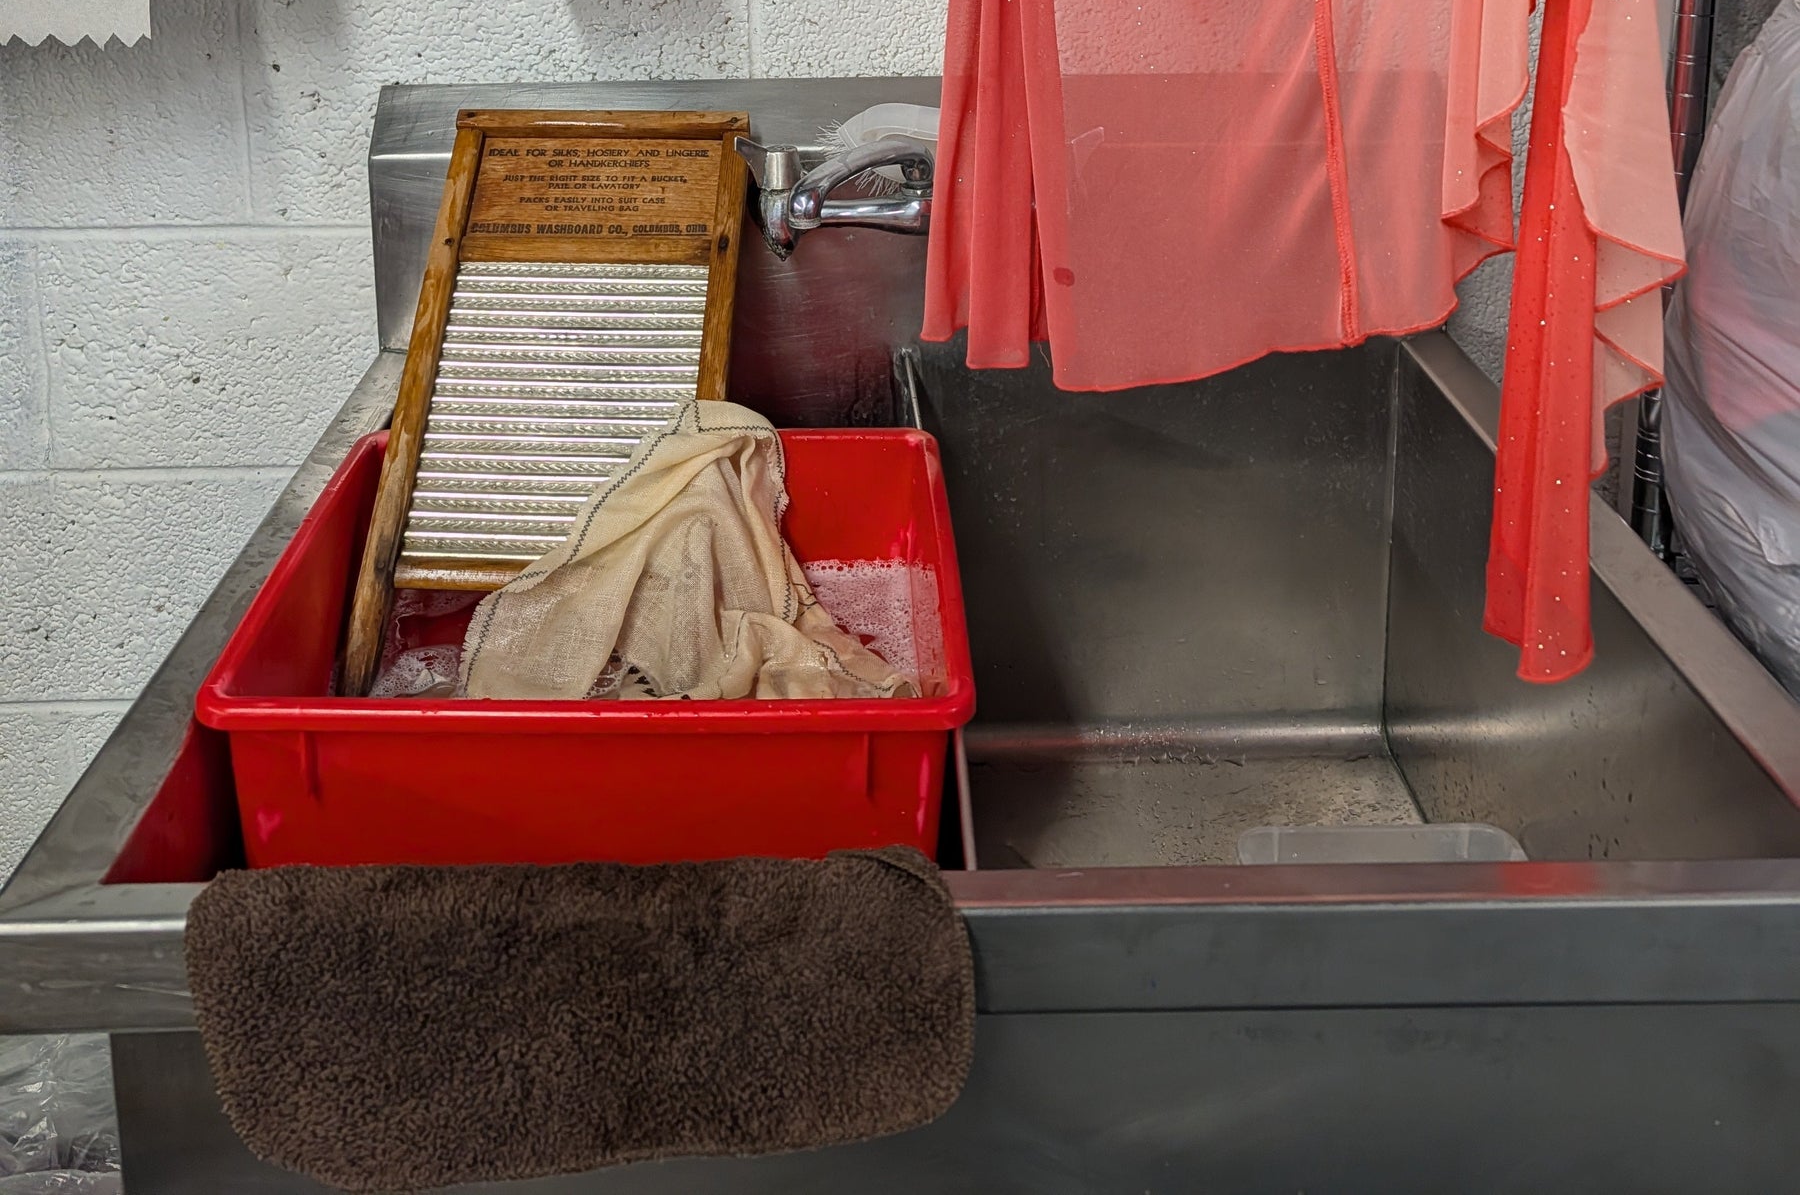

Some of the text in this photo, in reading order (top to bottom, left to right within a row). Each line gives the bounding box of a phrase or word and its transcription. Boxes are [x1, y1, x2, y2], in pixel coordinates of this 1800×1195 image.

[489, 148, 710, 158] IDEAL FOR SILKS, HOSIERY AND LINGERIE
[548, 159, 650, 168] OR HANDKERCHIEFS
[651, 175, 687, 183] BUCKET,
[470, 223, 707, 236] COLUMBUS WASHBOARD CO., COLUMBUS, OHIO
